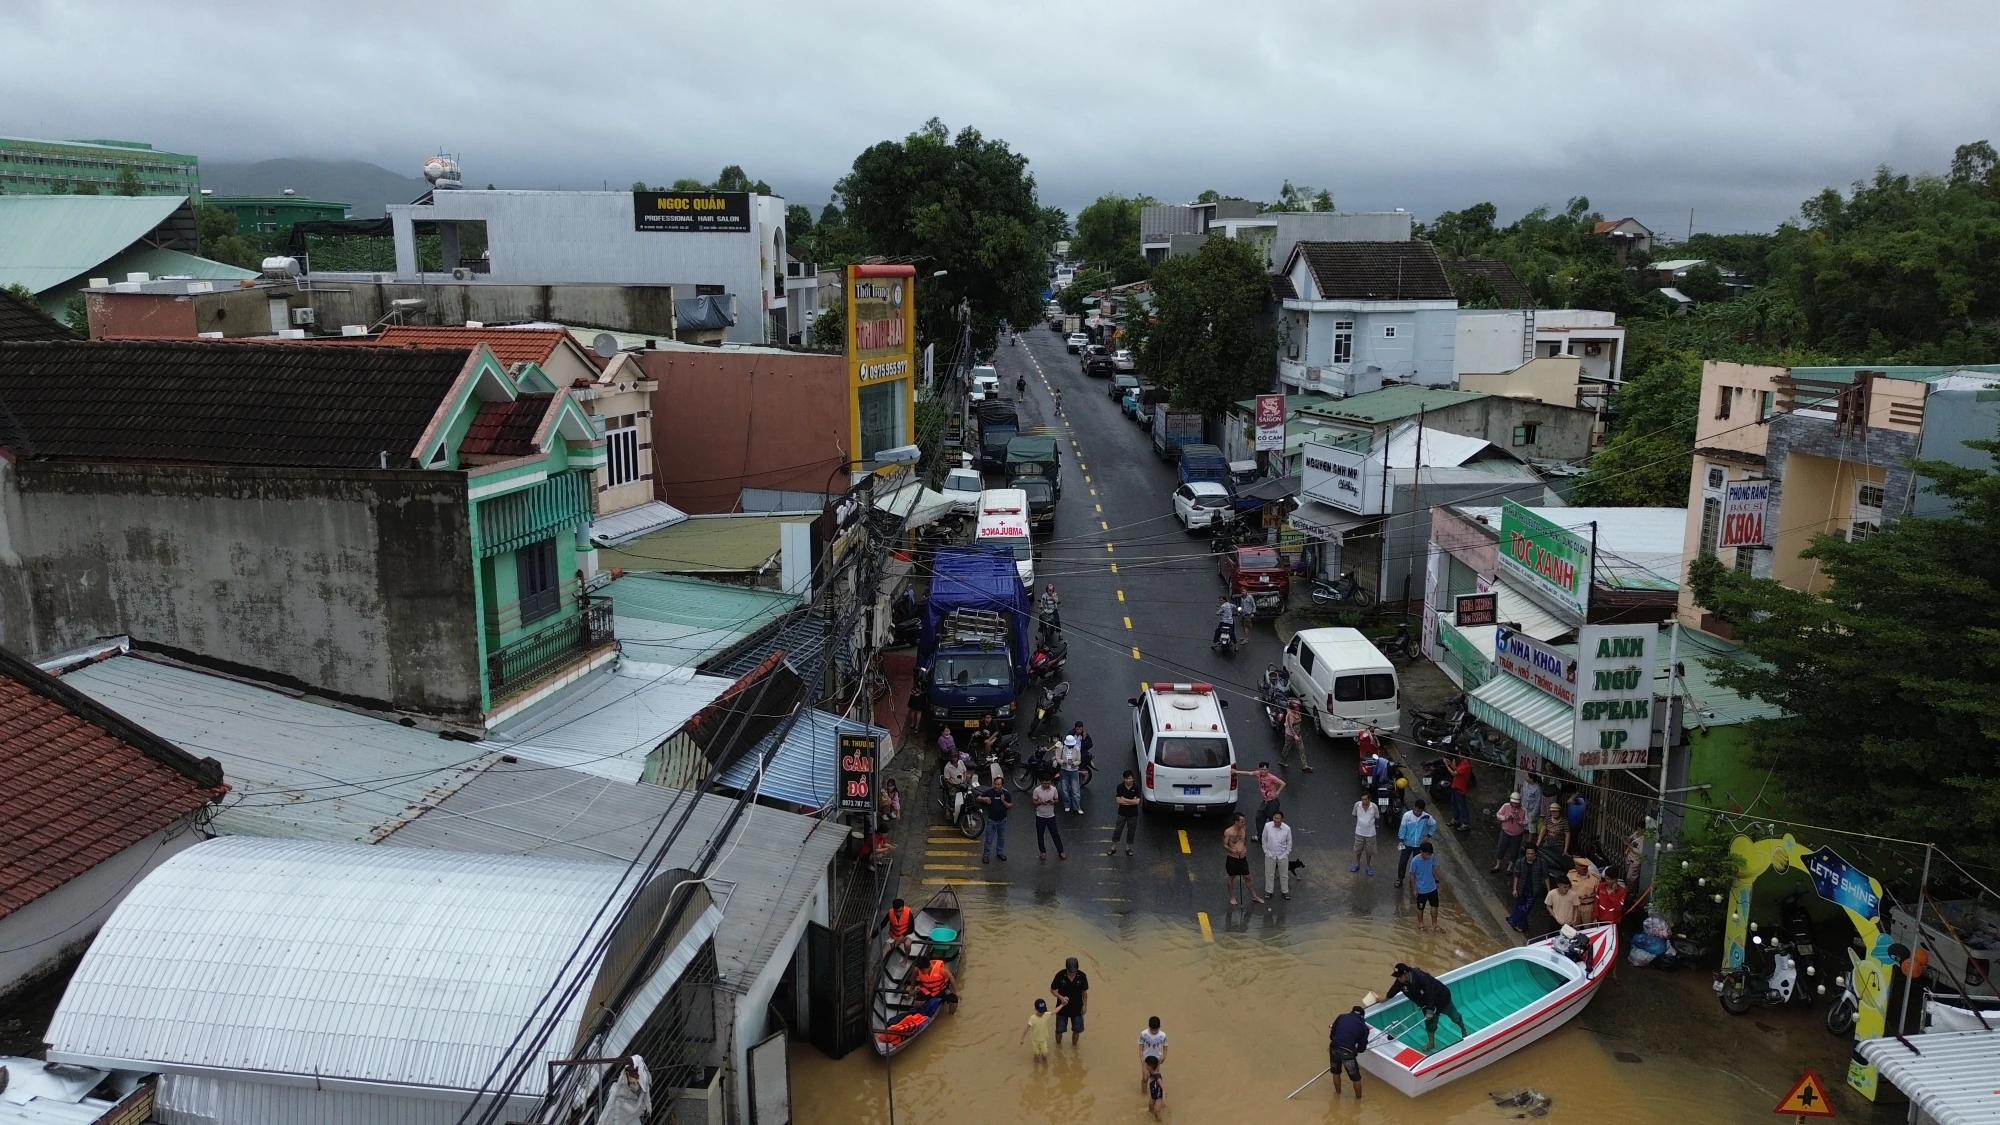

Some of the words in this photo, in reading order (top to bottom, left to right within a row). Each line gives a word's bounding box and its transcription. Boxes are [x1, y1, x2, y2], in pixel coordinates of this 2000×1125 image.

[657, 198, 690, 212] NGỌC
[1729, 483, 1750, 501] PHÒNG
[1750, 484, 1768, 500] RĂNG
[1730, 502, 1750, 510] BÁC
[1753, 502, 1763, 510] SĨ
[1724, 512, 1762, 545] KHOA
[1535, 544, 1574, 592] XANH
[1510, 638, 1530, 662] NHA
[1533, 649, 1562, 677] KHOA
[1596, 636, 1644, 658] ANH
[1593, 664, 1642, 690] NGỮ
[1581, 698, 1648, 720] SPEAK
[1599, 729, 1628, 749] UP
[1810, 858, 1839, 886] LET'S
[1840, 877, 1876, 908] SHINE
